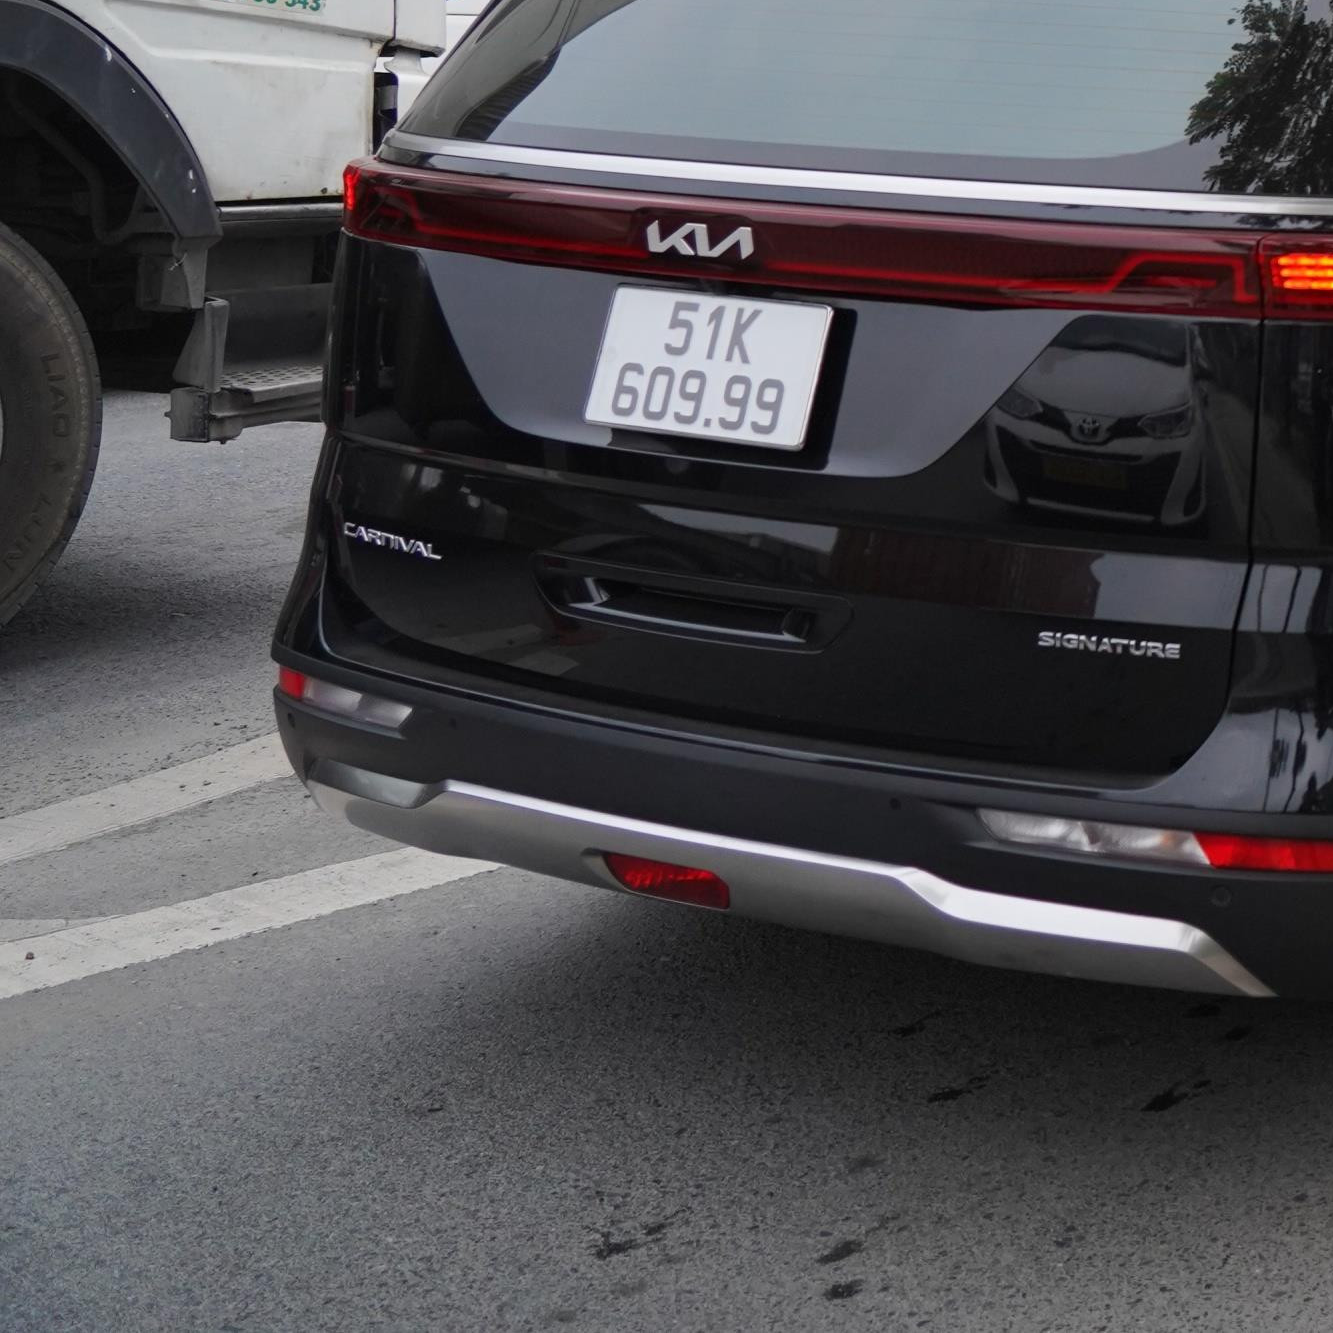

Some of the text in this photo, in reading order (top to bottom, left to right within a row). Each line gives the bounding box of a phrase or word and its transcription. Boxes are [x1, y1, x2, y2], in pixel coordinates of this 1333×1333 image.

[664, 301, 763, 364] 51K
[611, 362, 785, 435] 609.99
[344, 521, 442, 560] CARNIVAL
[1037, 630, 1182, 659] SIGNATURE
